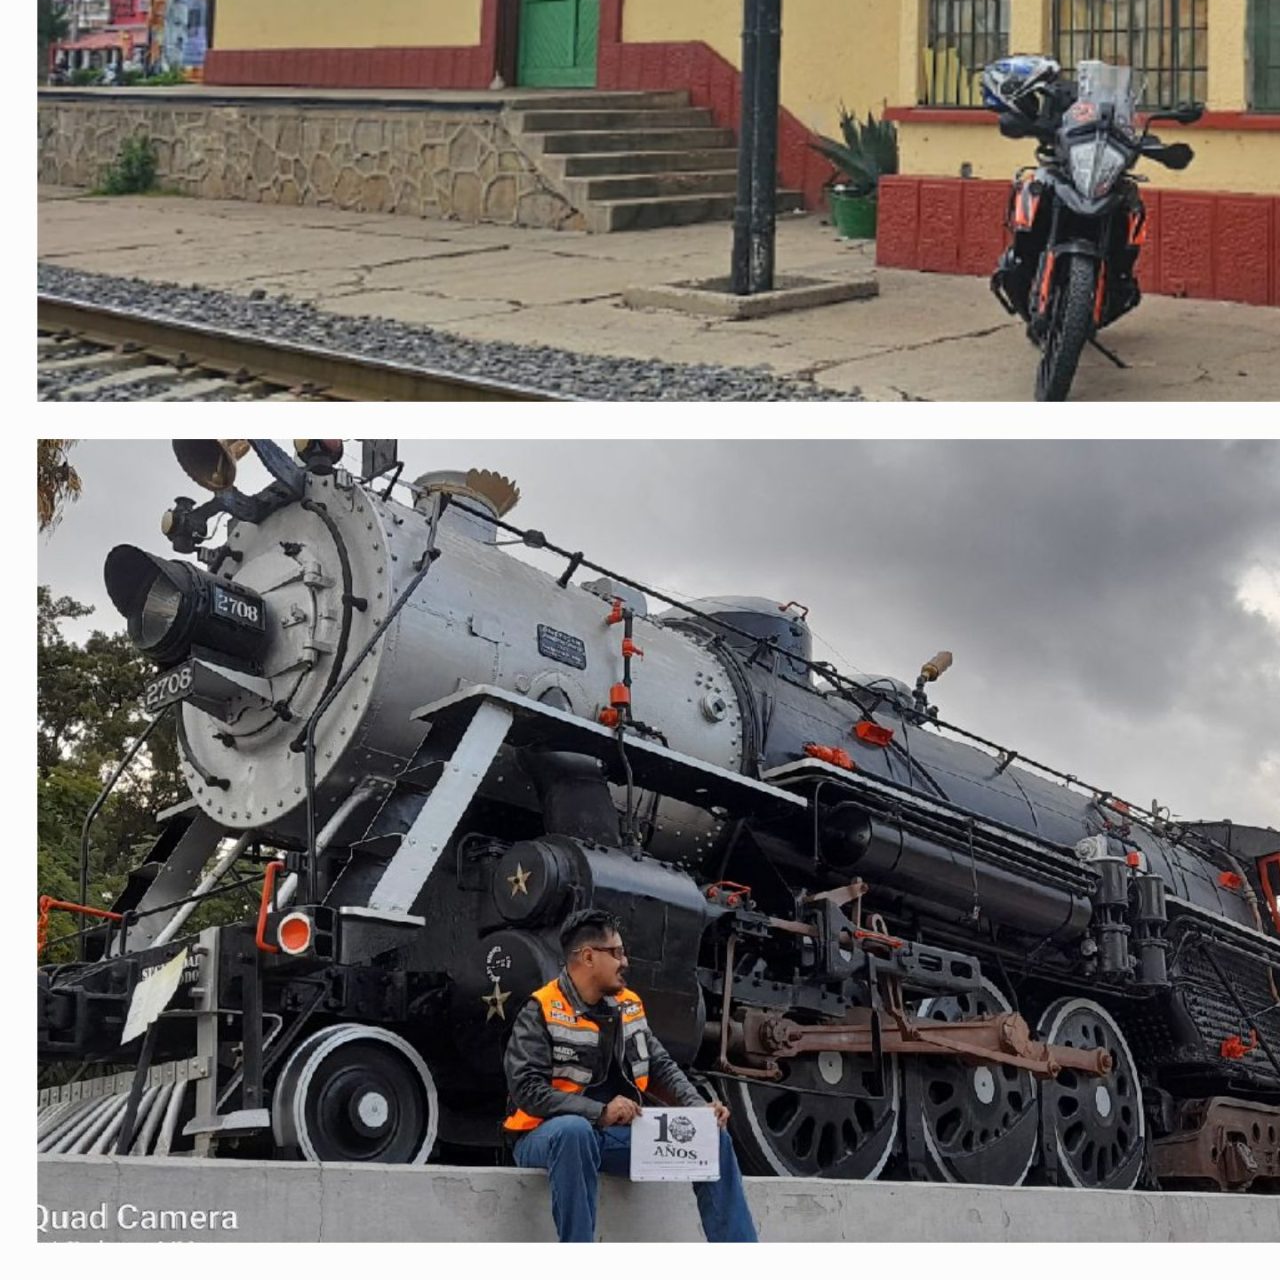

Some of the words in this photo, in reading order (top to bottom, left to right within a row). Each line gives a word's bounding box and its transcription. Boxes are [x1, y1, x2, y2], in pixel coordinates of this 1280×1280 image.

[217, 595, 258, 621] 2708
[147, 667, 193, 706] 2708
[653, 1144, 698, 1160] AÑOS
